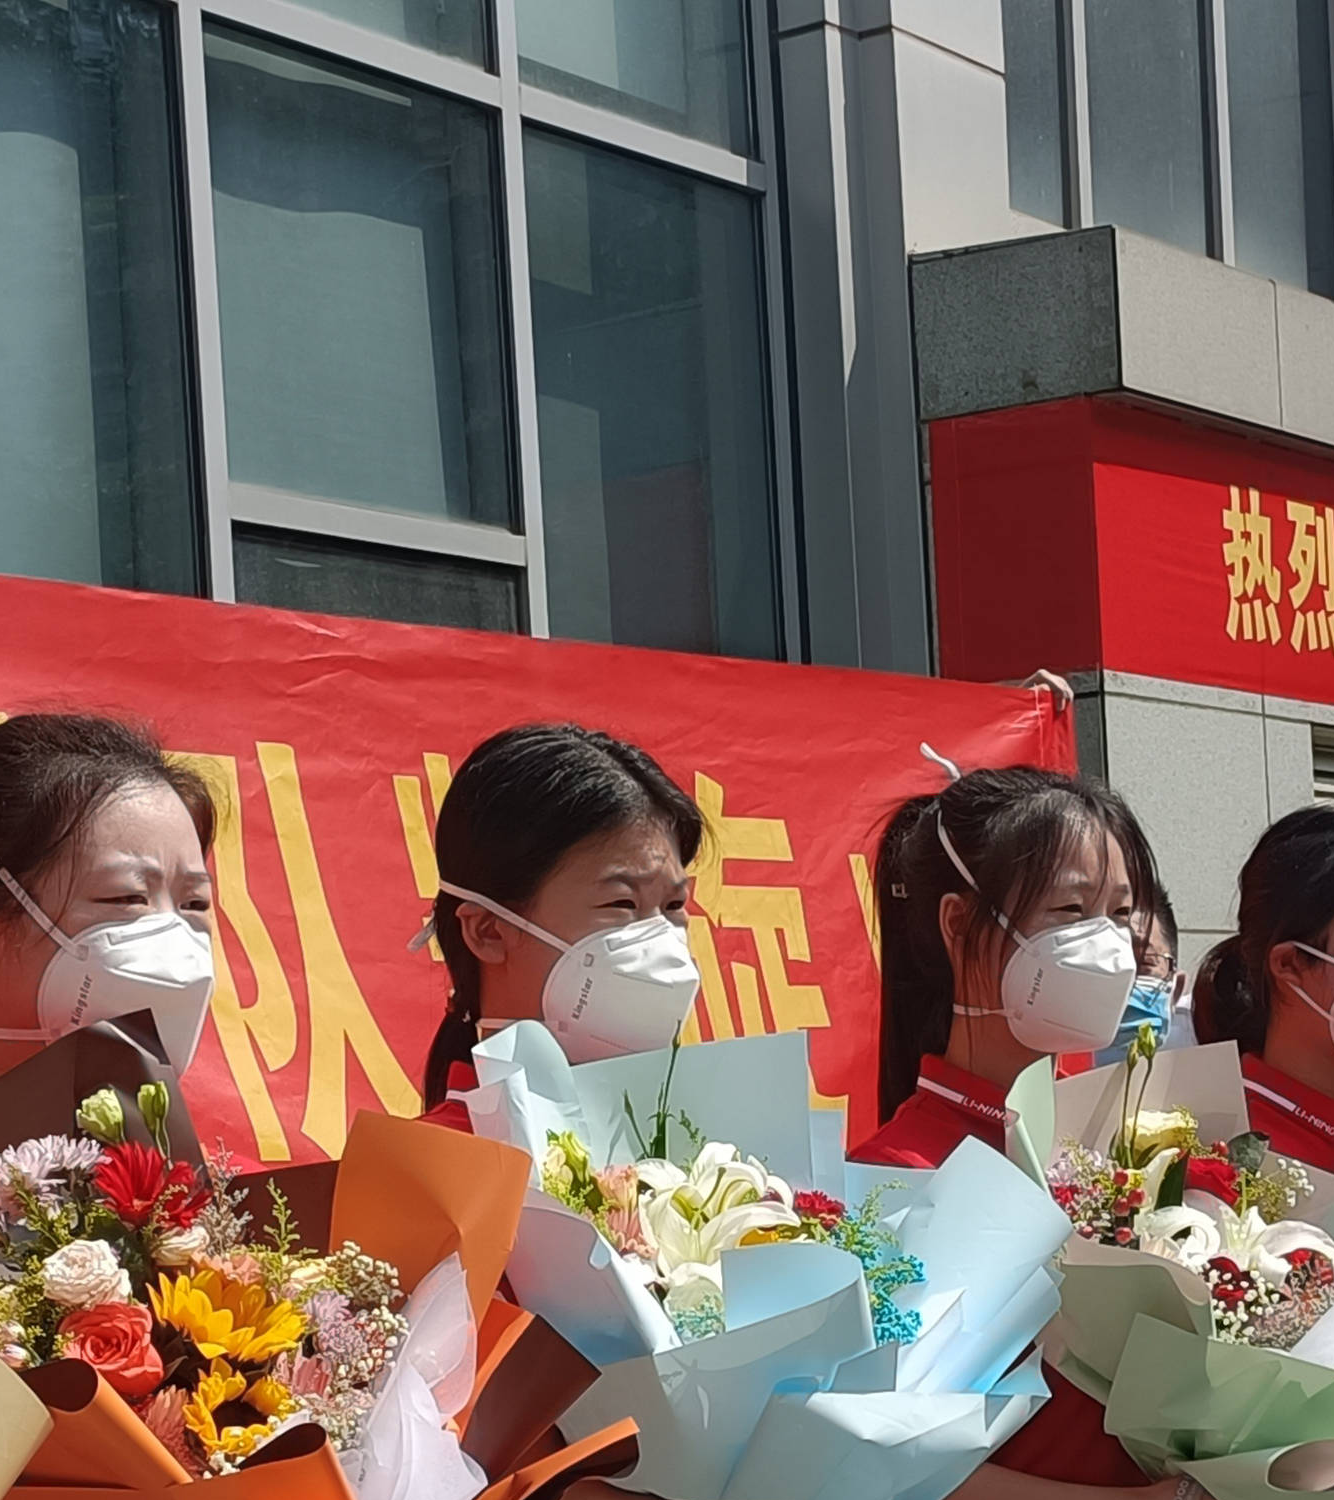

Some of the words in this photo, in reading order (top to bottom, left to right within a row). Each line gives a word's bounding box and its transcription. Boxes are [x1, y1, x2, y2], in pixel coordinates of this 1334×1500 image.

[69, 973, 93, 1026] Kingstar
[571, 977, 594, 1021] Kingstar
[1026, 967, 1044, 1006] Kingstar
